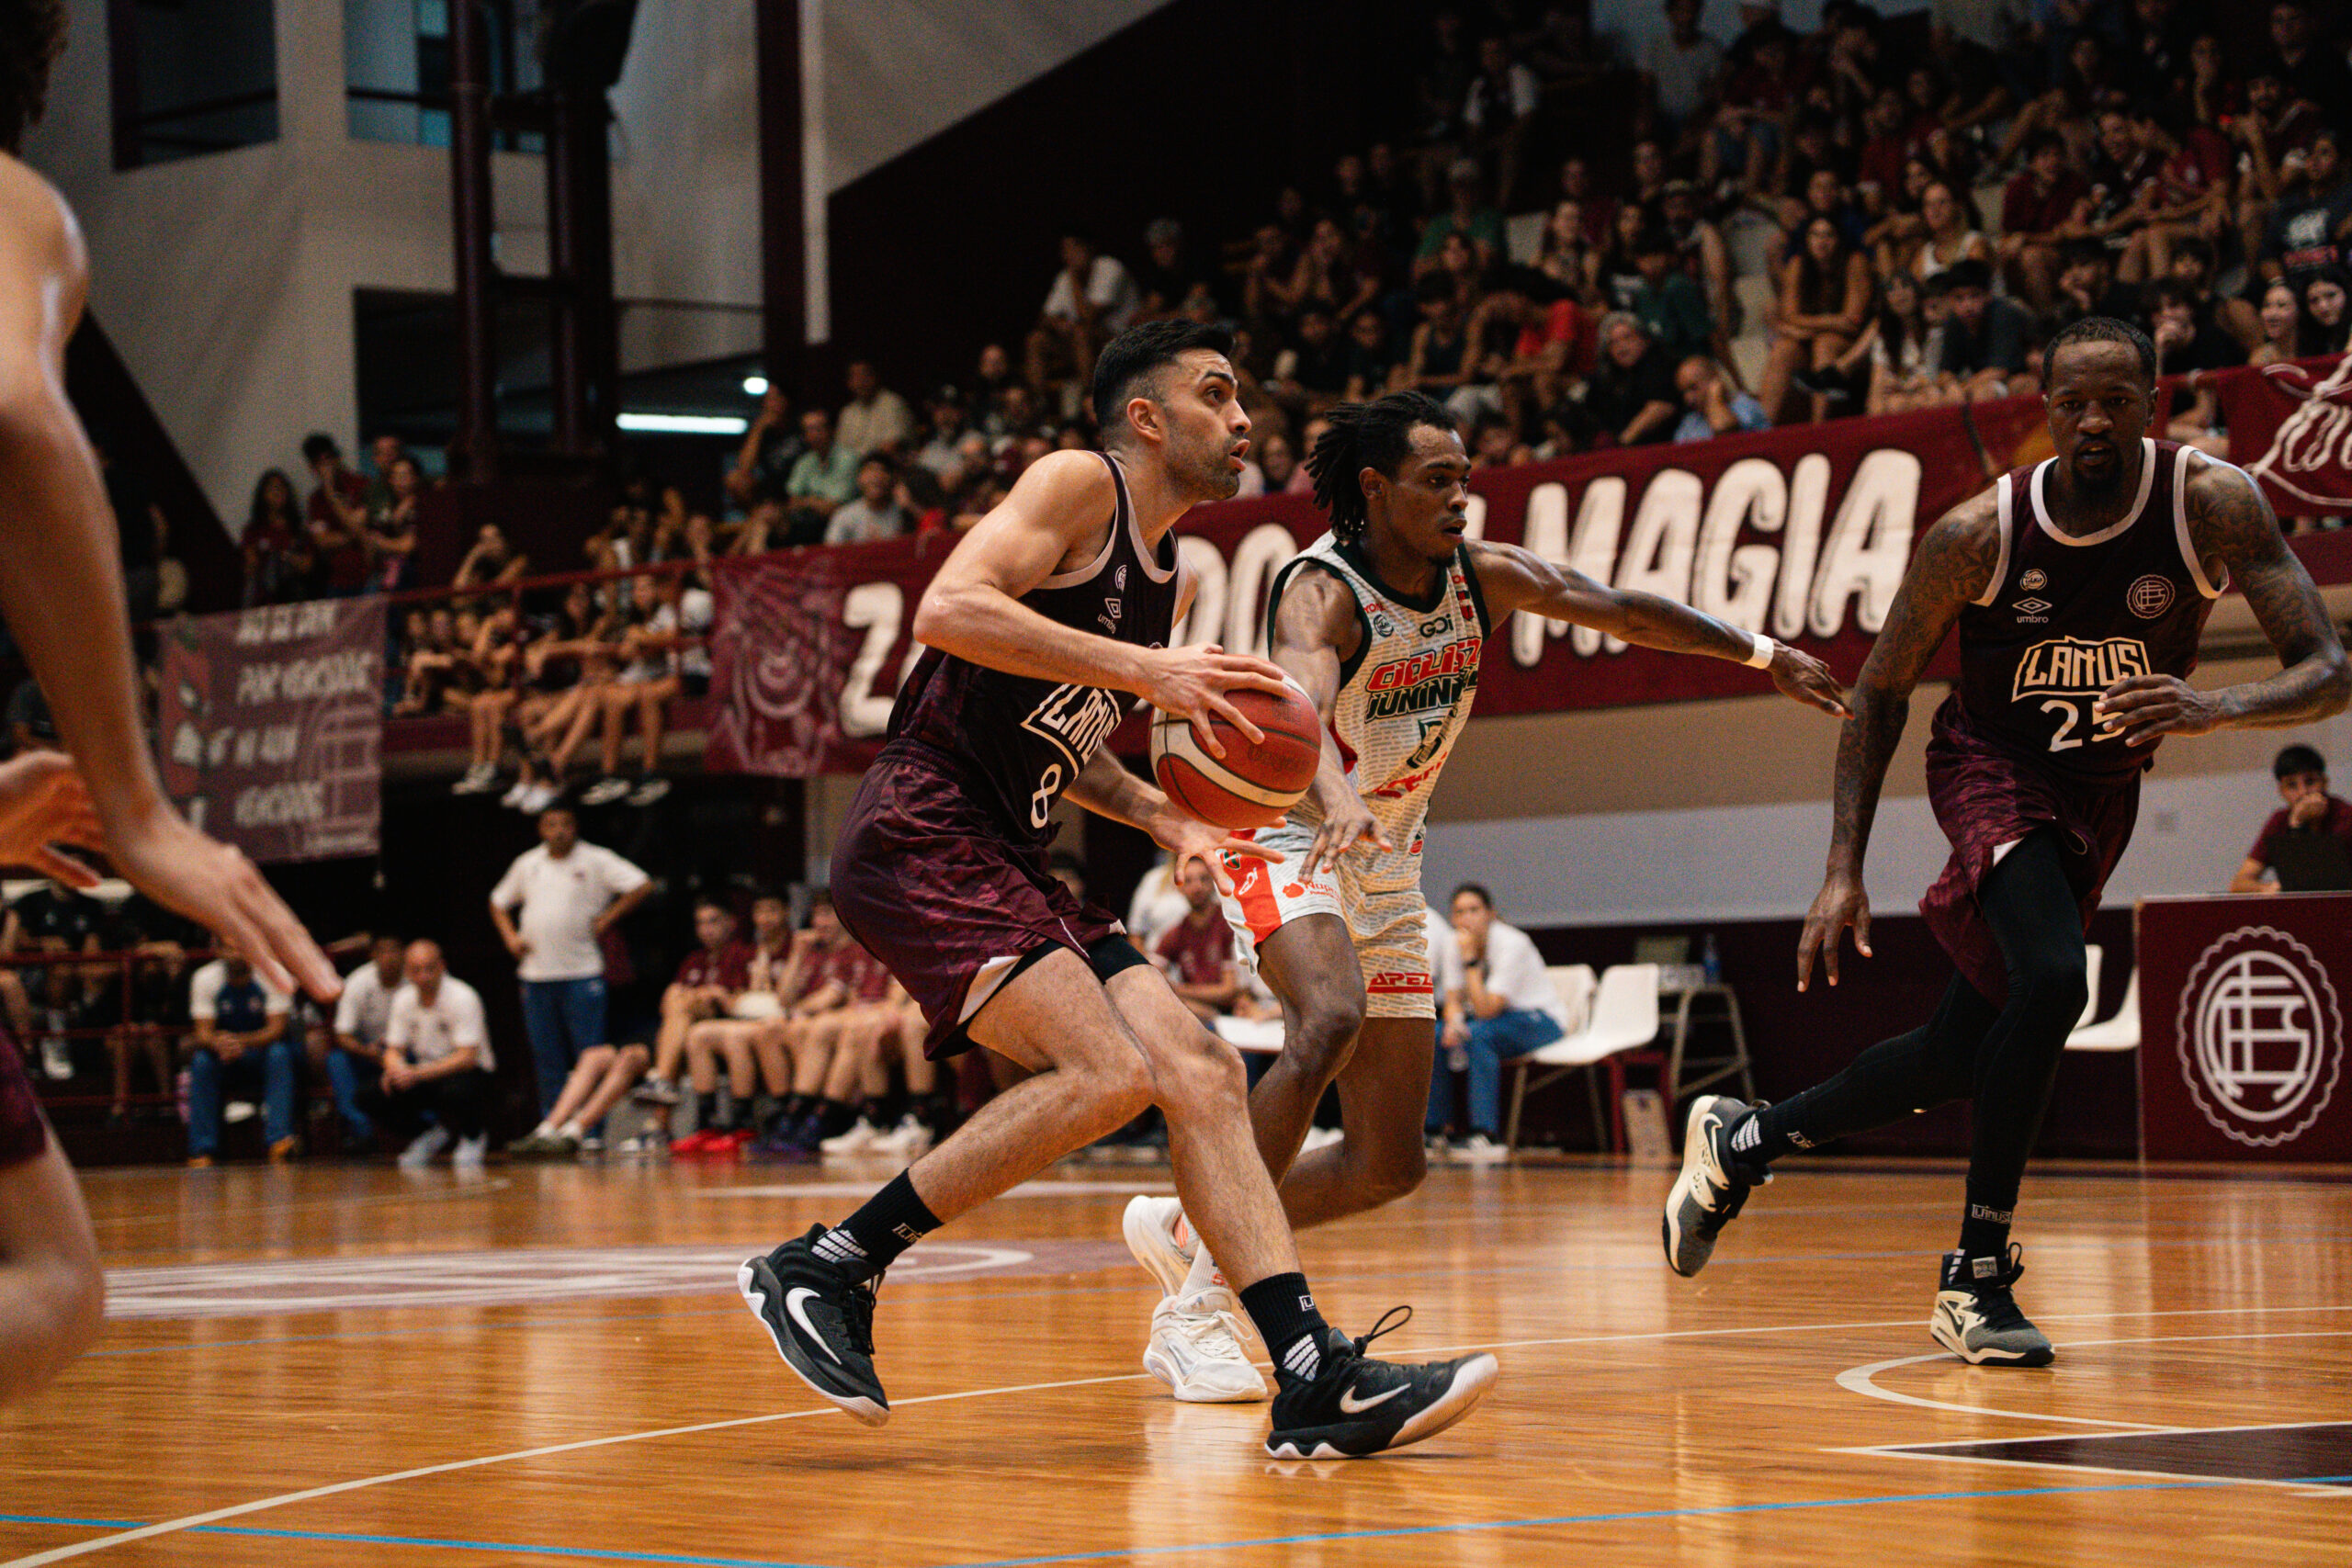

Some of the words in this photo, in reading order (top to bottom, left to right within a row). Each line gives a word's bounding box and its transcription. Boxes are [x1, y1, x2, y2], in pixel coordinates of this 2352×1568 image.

[1511, 448, 1922, 668] MAGIA
[2016, 615, 2049, 624] umbro
[2040, 699, 2126, 753] 25
[1030, 763, 1062, 829] 8
